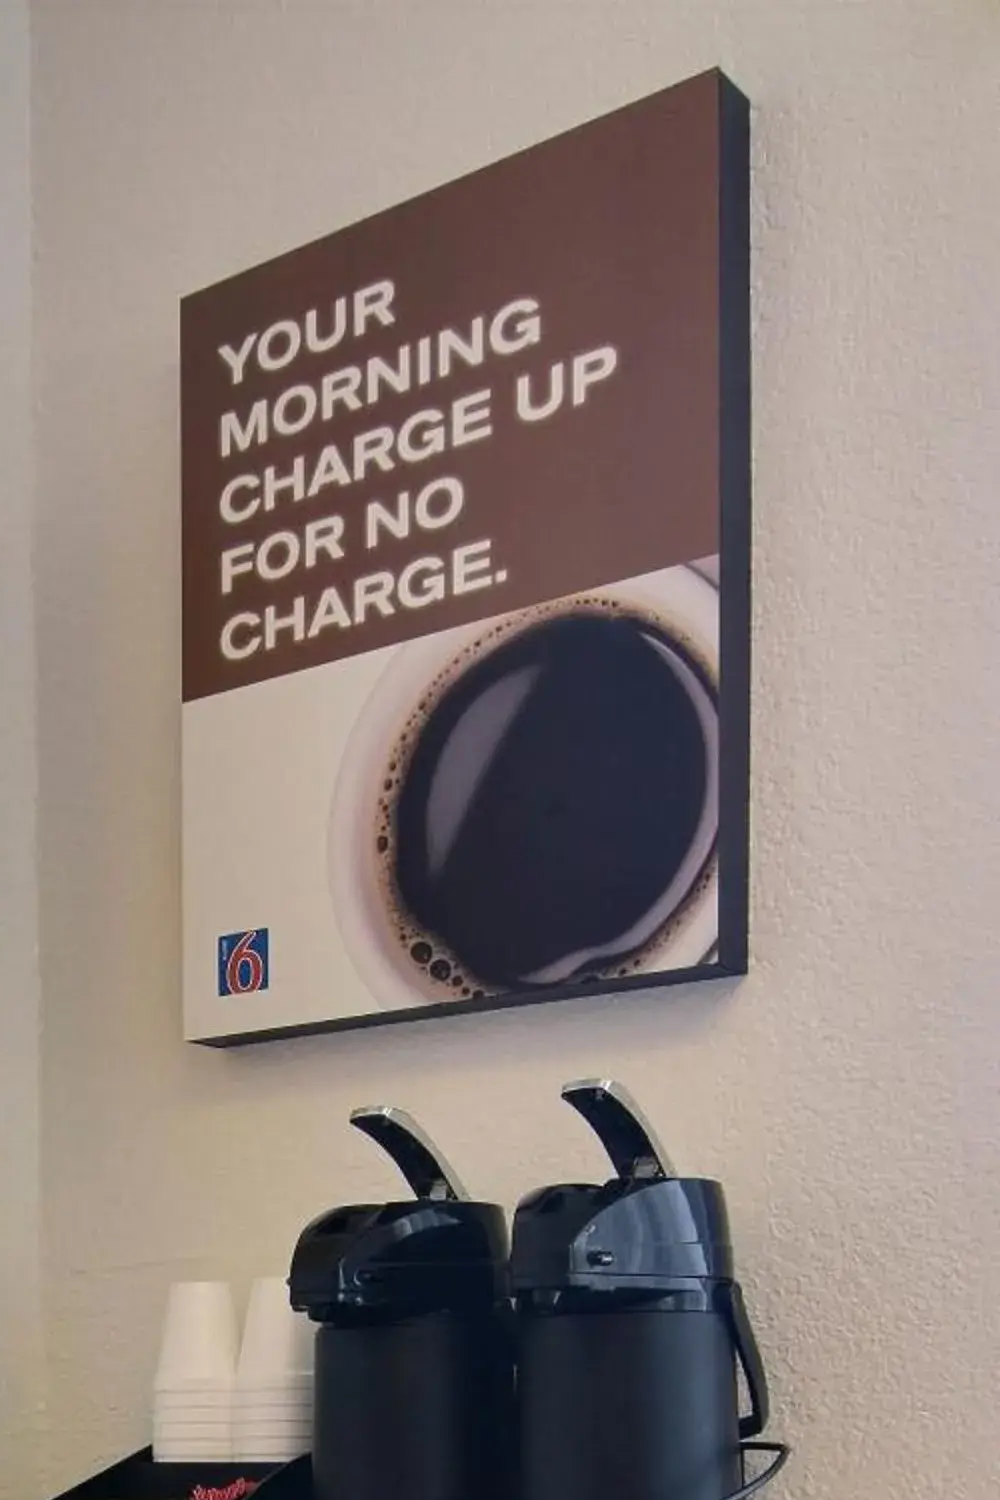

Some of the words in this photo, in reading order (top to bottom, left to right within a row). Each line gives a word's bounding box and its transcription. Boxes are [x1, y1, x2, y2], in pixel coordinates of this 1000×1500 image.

[218, 280, 396, 386] YOUR
[221, 298, 542, 458] MORNING
[219, 388, 493, 524] CHARGE
[516, 346, 617, 422] UP
[221, 515, 345, 594] FOR
[366, 476, 465, 549] NO
[219, 538, 508, 660] CHARGE.
[226, 929, 263, 994] 6
